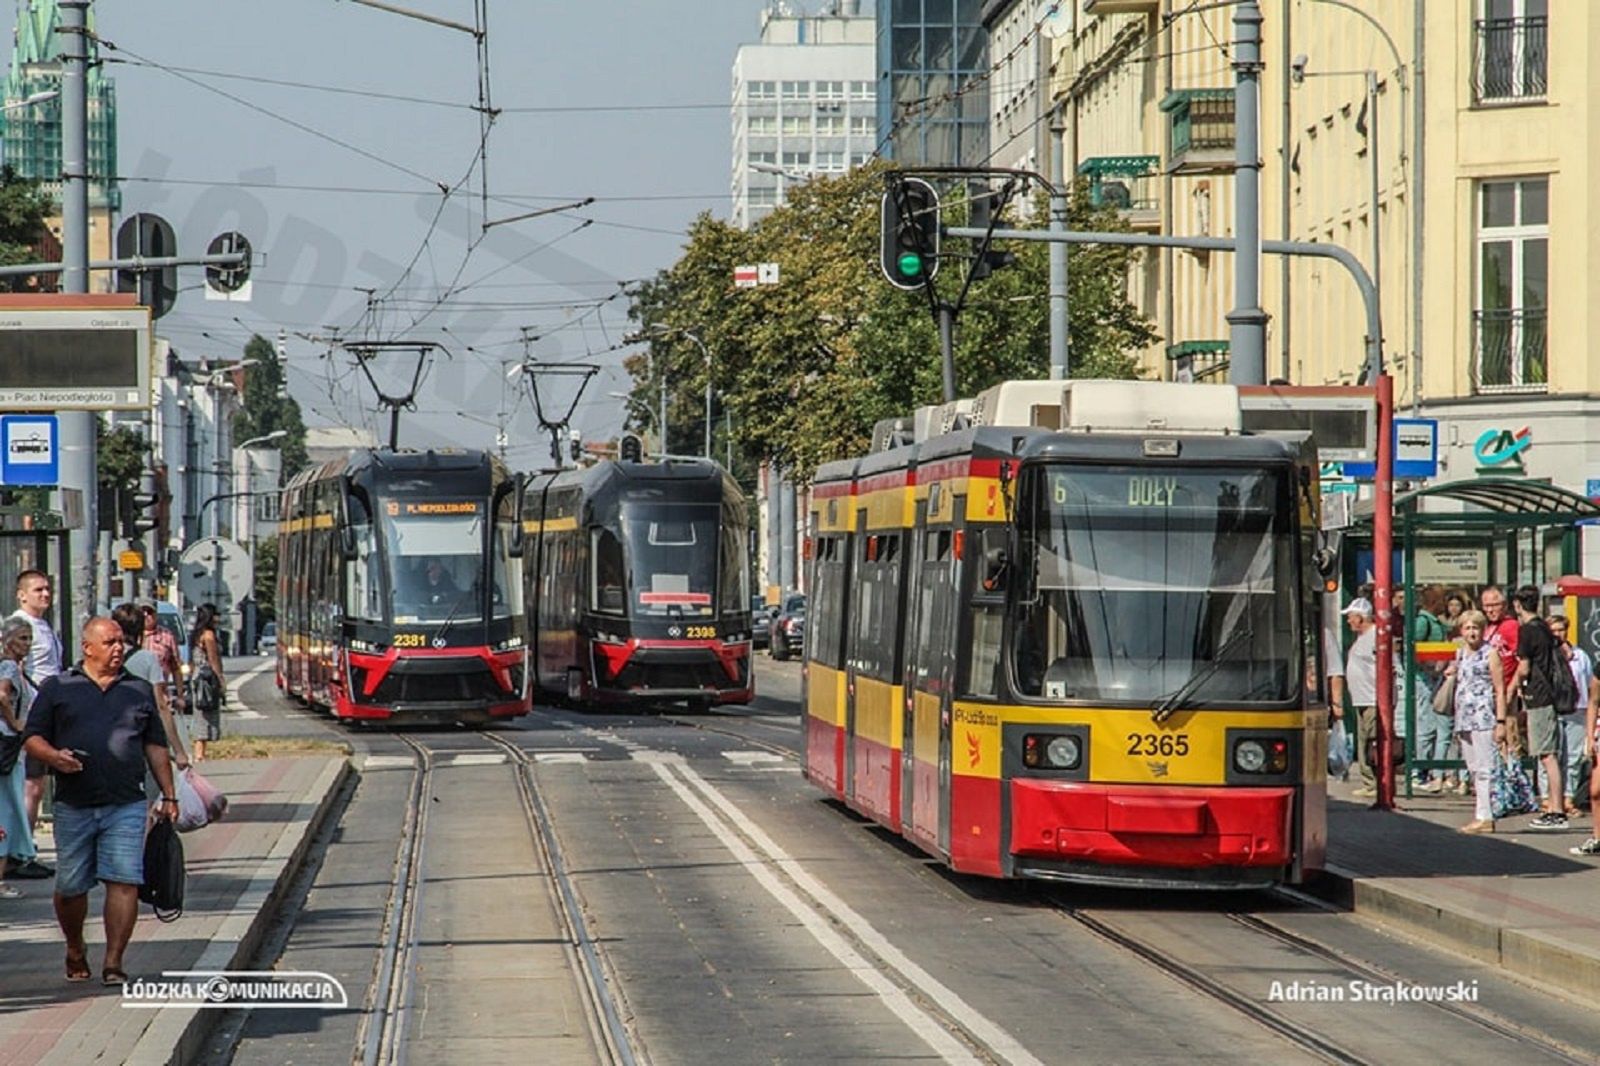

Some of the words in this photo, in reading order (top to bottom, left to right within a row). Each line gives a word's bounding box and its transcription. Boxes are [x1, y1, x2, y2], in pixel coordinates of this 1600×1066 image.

[1055, 479, 1066, 504] 6
[1129, 476, 1176, 506] DOŁY
[393, 634, 426, 647] 2381
[686, 626, 716, 638] 2398
[1127, 733, 1189, 757] 2365
